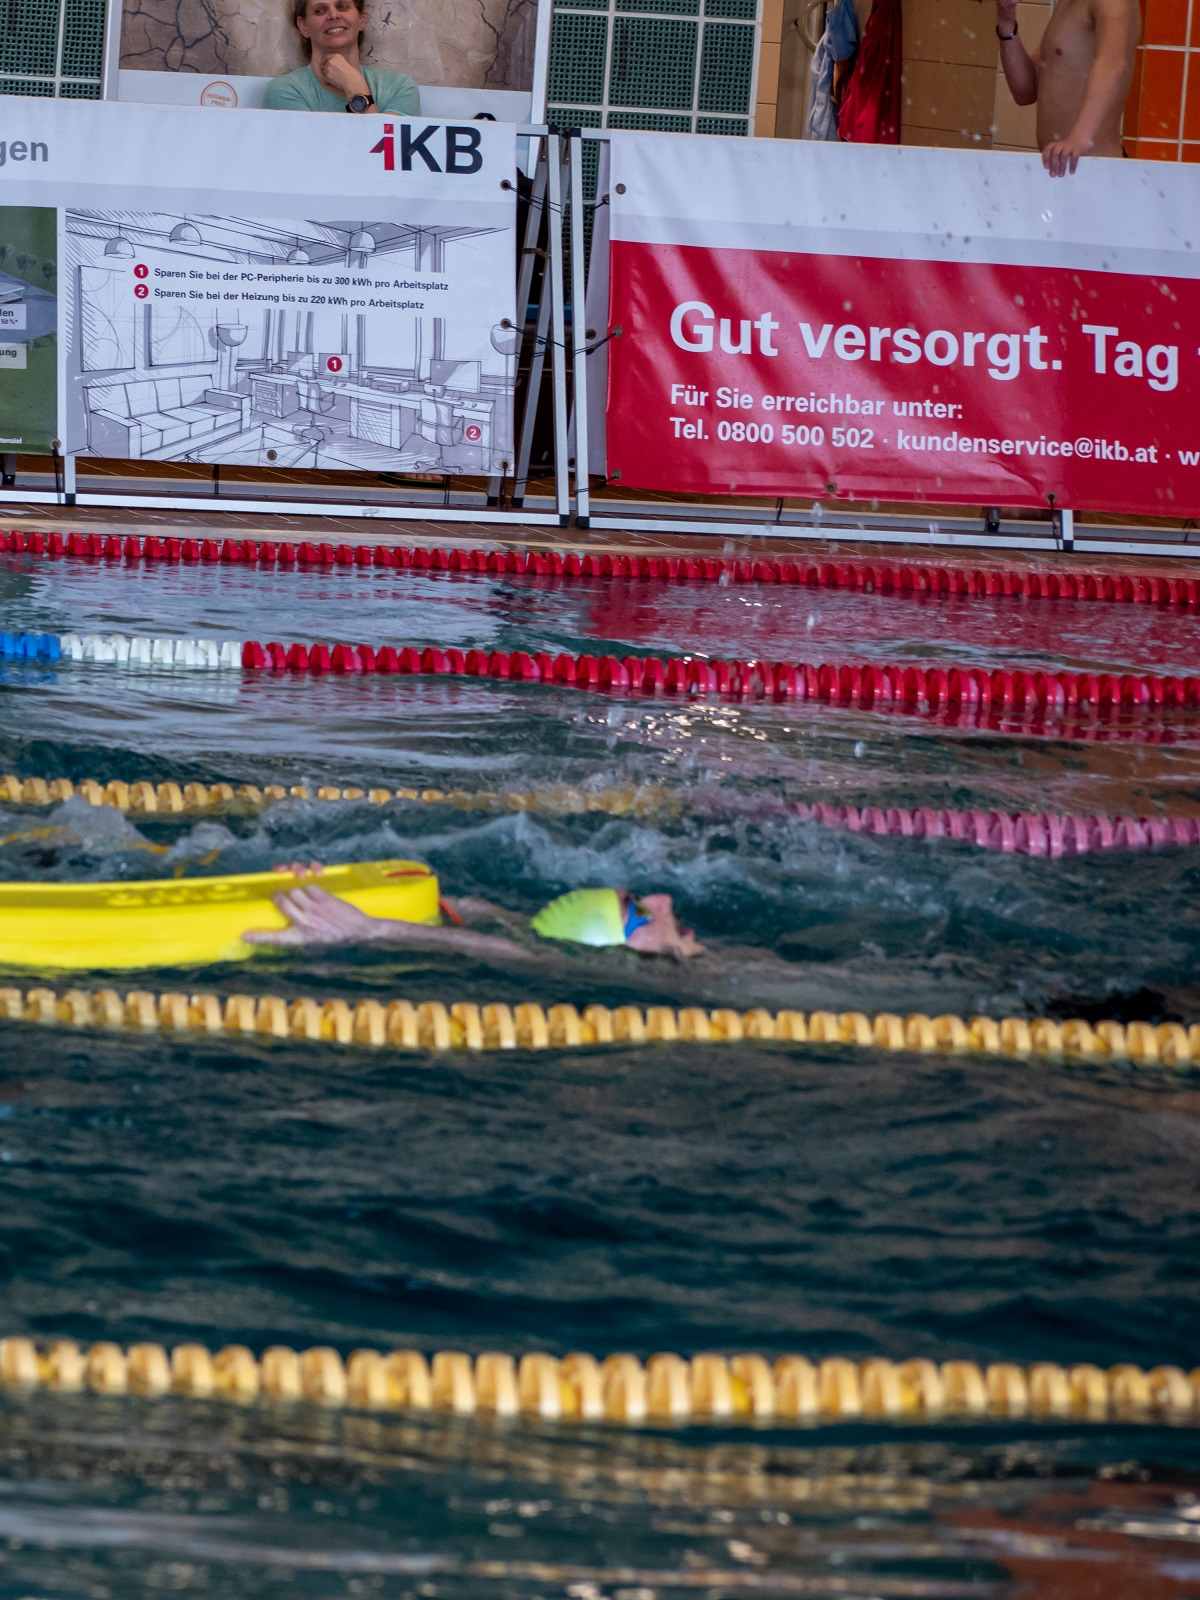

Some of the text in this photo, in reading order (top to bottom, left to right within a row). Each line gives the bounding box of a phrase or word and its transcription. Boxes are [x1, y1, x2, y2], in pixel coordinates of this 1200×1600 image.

[369, 123, 483, 174] iKB
[154, 268, 187, 279] Sparen
[189, 270, 203, 280] Sie
[206, 271, 220, 281] bei
[222, 273, 239, 282] der
[240, 273, 305, 284] PC-Peripherie
[306, 275, 320, 284] bis
[334, 277, 350, 286] 300
[352, 278, 372, 287] kWh
[375, 281, 390, 289] pro
[393, 280, 449, 292] Arbeitsplatz
[154, 288, 187, 299] Sparen
[188, 290, 203, 300] Sie
[206, 291, 220, 301] bei
[222, 292, 239, 301] der
[241, 293, 280, 304] Heizung
[282, 294, 296, 303] bis
[310, 296, 326, 305] 220
[328, 297, 348, 306] kWh
[350, 299, 366, 308] pro
[368, 299, 425, 311] Arbeitsplatz
[670, 300, 1179, 392] Gut versorgt. Tag
[671, 383, 964, 420] Für Sie erreichbar unter:
[669, 417, 710, 440] Tel.
[717, 421, 775, 444] 0800
[781, 424, 825, 447] 500
[831, 427, 875, 449] 502
[897, 429, 1159, 464] kundenservice@ikb.at
